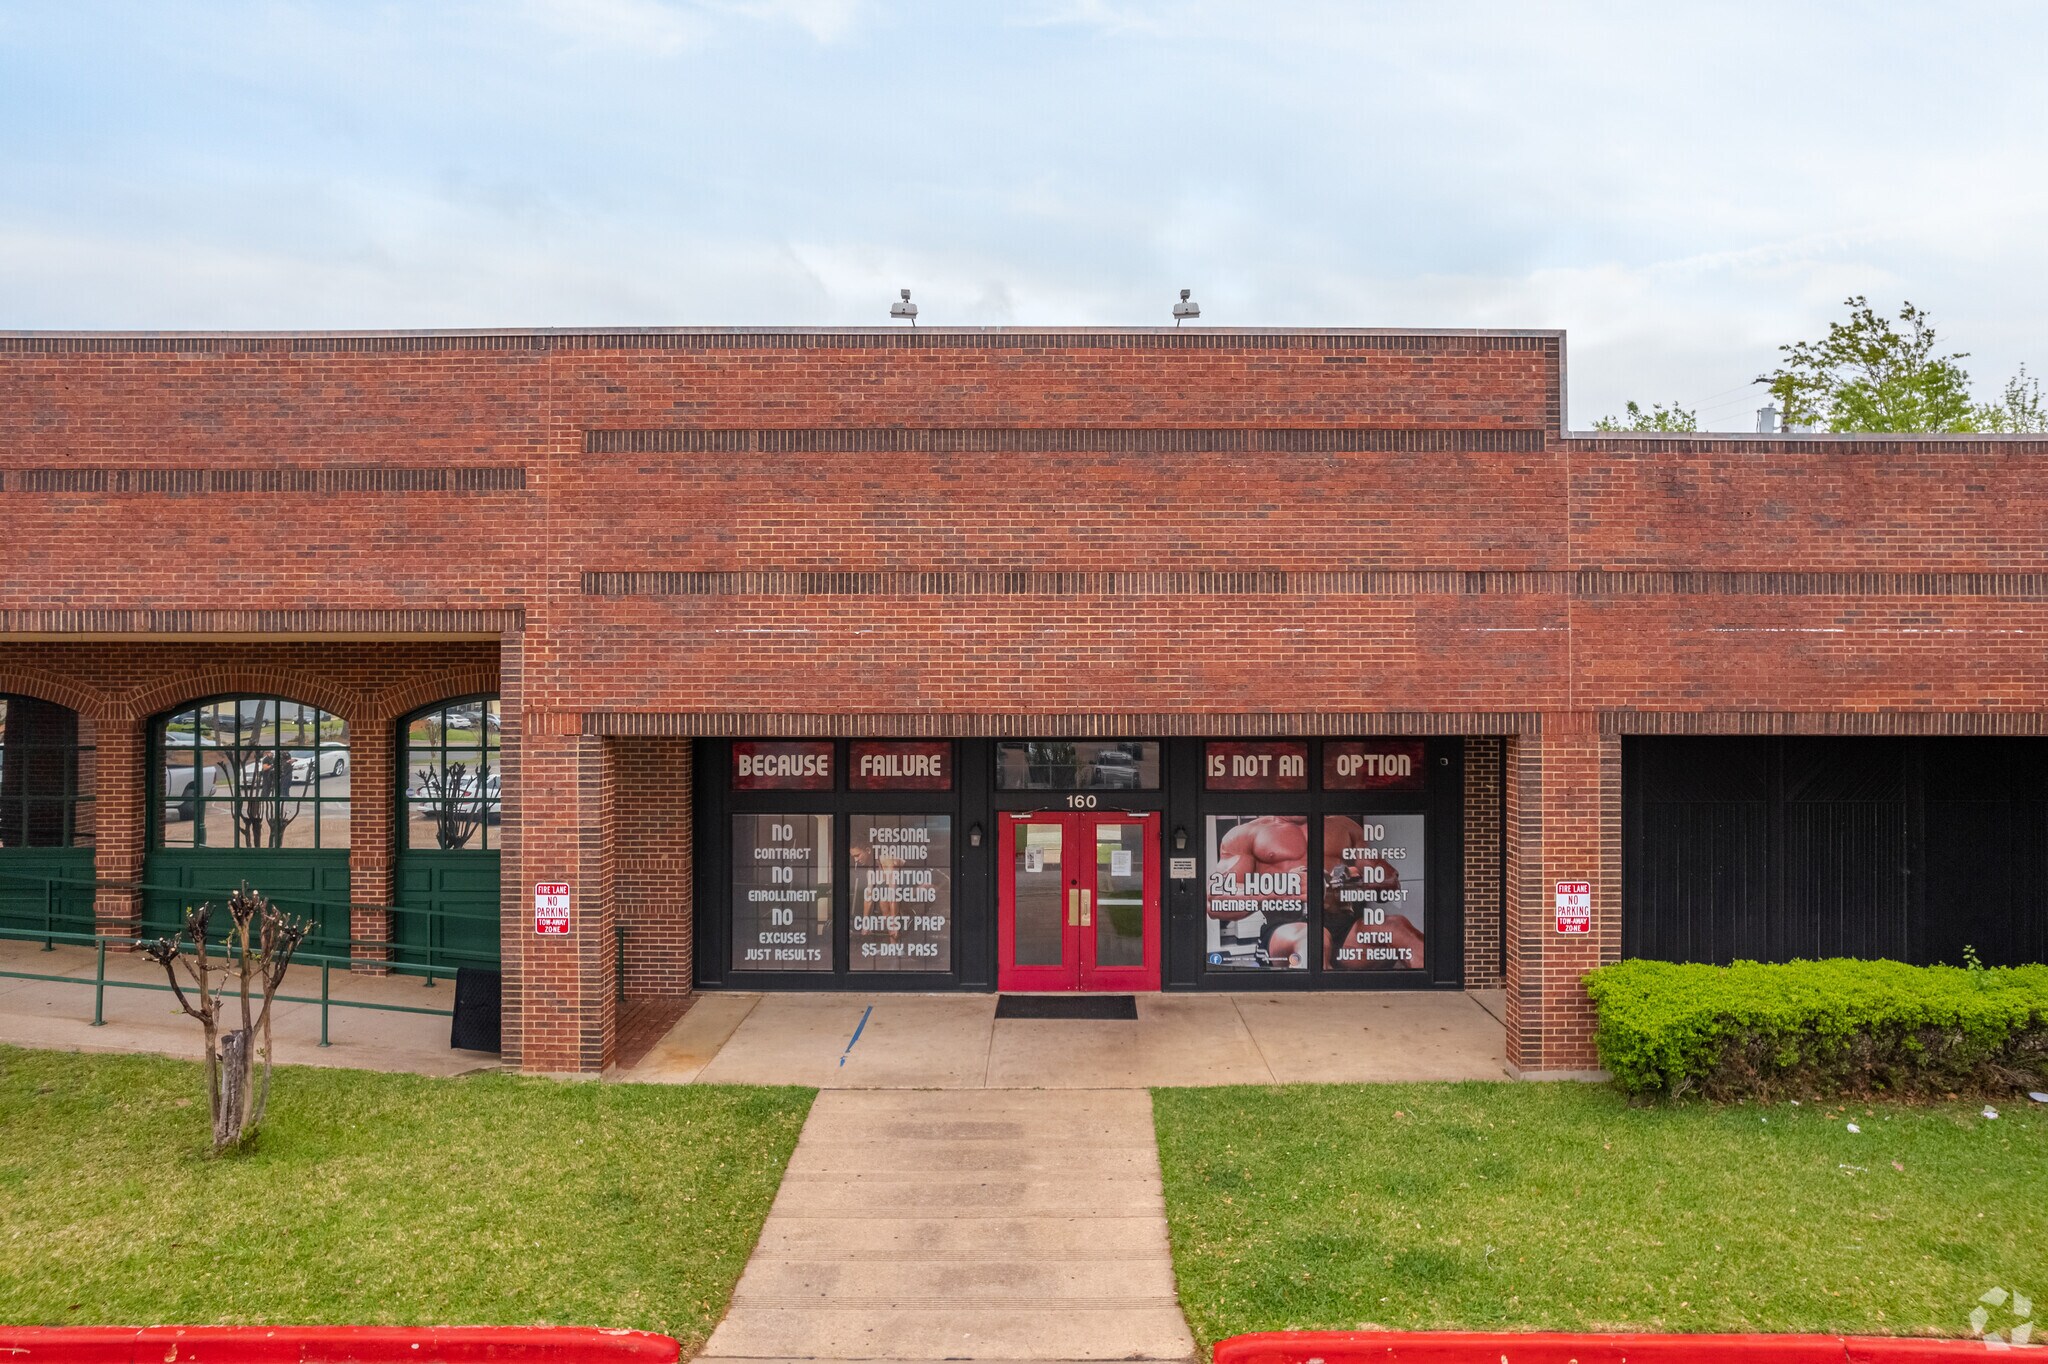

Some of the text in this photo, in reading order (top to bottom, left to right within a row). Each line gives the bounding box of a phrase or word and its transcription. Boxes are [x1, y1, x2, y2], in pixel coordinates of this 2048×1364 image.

[739, 754, 828, 776] BECAUSE
[861, 754, 941, 776] FAILURE
[1208, 755, 1304, 777] IS NOT AN
[1337, 754, 1411, 776] OPTION
[1066, 795, 1097, 808] 160
[772, 824, 793, 841] NO
[869, 828, 930, 843] PERSONAL
[1363, 824, 1385, 841] NO
[754, 848, 811, 859] CONTRACT
[872, 845, 928, 860] TRAINING
[1342, 848, 1407, 860] EXTRA FEES
[772, 866, 793, 883] NO
[867, 870, 932, 885] NUTRITION
[1363, 866, 1385, 883] NO
[538, 886, 567, 894] FIRE LANE
[1210, 872, 1301, 895] 24 HOUR
[1559, 885, 1588, 893] FIRE LANE
[547, 896, 558, 906] NO
[748, 890, 817, 902] ENROLLMENT
[863, 887, 936, 902] COUNSELING
[1340, 890, 1408, 902] HIDDEN COST
[1568, 895, 1579, 905] NO
[537, 907, 568, 917] PARKING
[1211, 900, 1302, 911] MEMBER ACCESS
[1558, 906, 1589, 916] PARKING
[772, 908, 793, 925] NO
[1363, 908, 1385, 925] NO
[854, 916, 946, 931] CONTEST PREP
[759, 932, 807, 944] EXCUSES
[1356, 932, 1393, 944] CATCH
[745, 949, 821, 961] JUST RESULTS
[880, 943, 904, 956] DAY
[908, 943, 938, 956] PASS
[1336, 948, 1412, 961] JUST RESULTS
